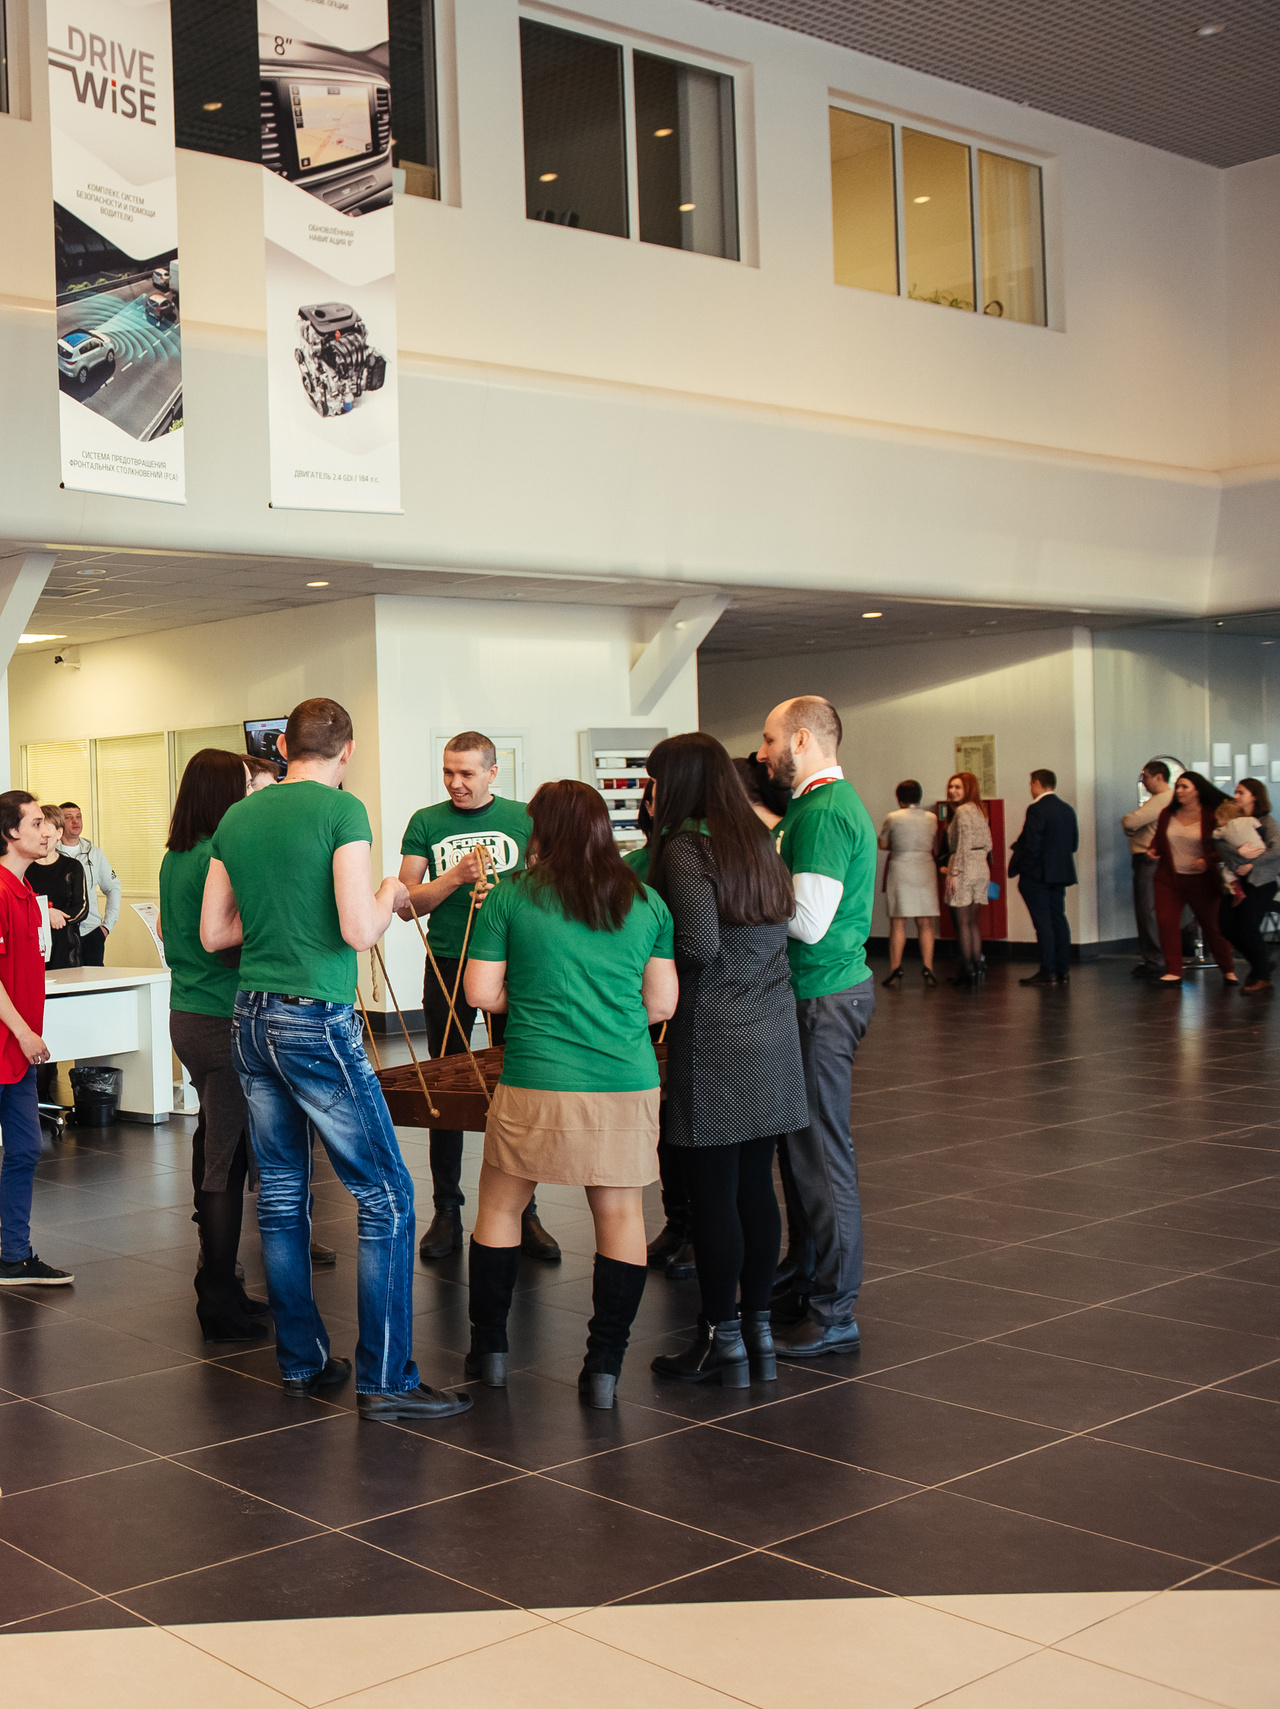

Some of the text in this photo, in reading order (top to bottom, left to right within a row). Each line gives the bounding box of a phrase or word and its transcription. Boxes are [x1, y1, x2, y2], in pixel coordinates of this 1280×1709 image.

[67, 25, 156, 87] DRIVE
[76, 189, 156, 218] БЕЗОПАСНОСТИ И ПОМОЩИ
[87, 182, 145, 205] КОМПЛЕКС СИСТЕМ
[100, 206, 134, 223] ВОДИТЕЛЮ
[68, 459, 179, 481] ФРОНТАЛЬНЫХ СТОЛКНОВЕНИЙ (FCA)
[81, 450, 167, 469] СИСТЕМА ПРЕДОТВРАЩЕНИЯ
[294, 469, 332, 480] ДВИГАТЕЛЬ
[452, 836, 493, 849] FORT
[431, 832, 520, 877] BORD
